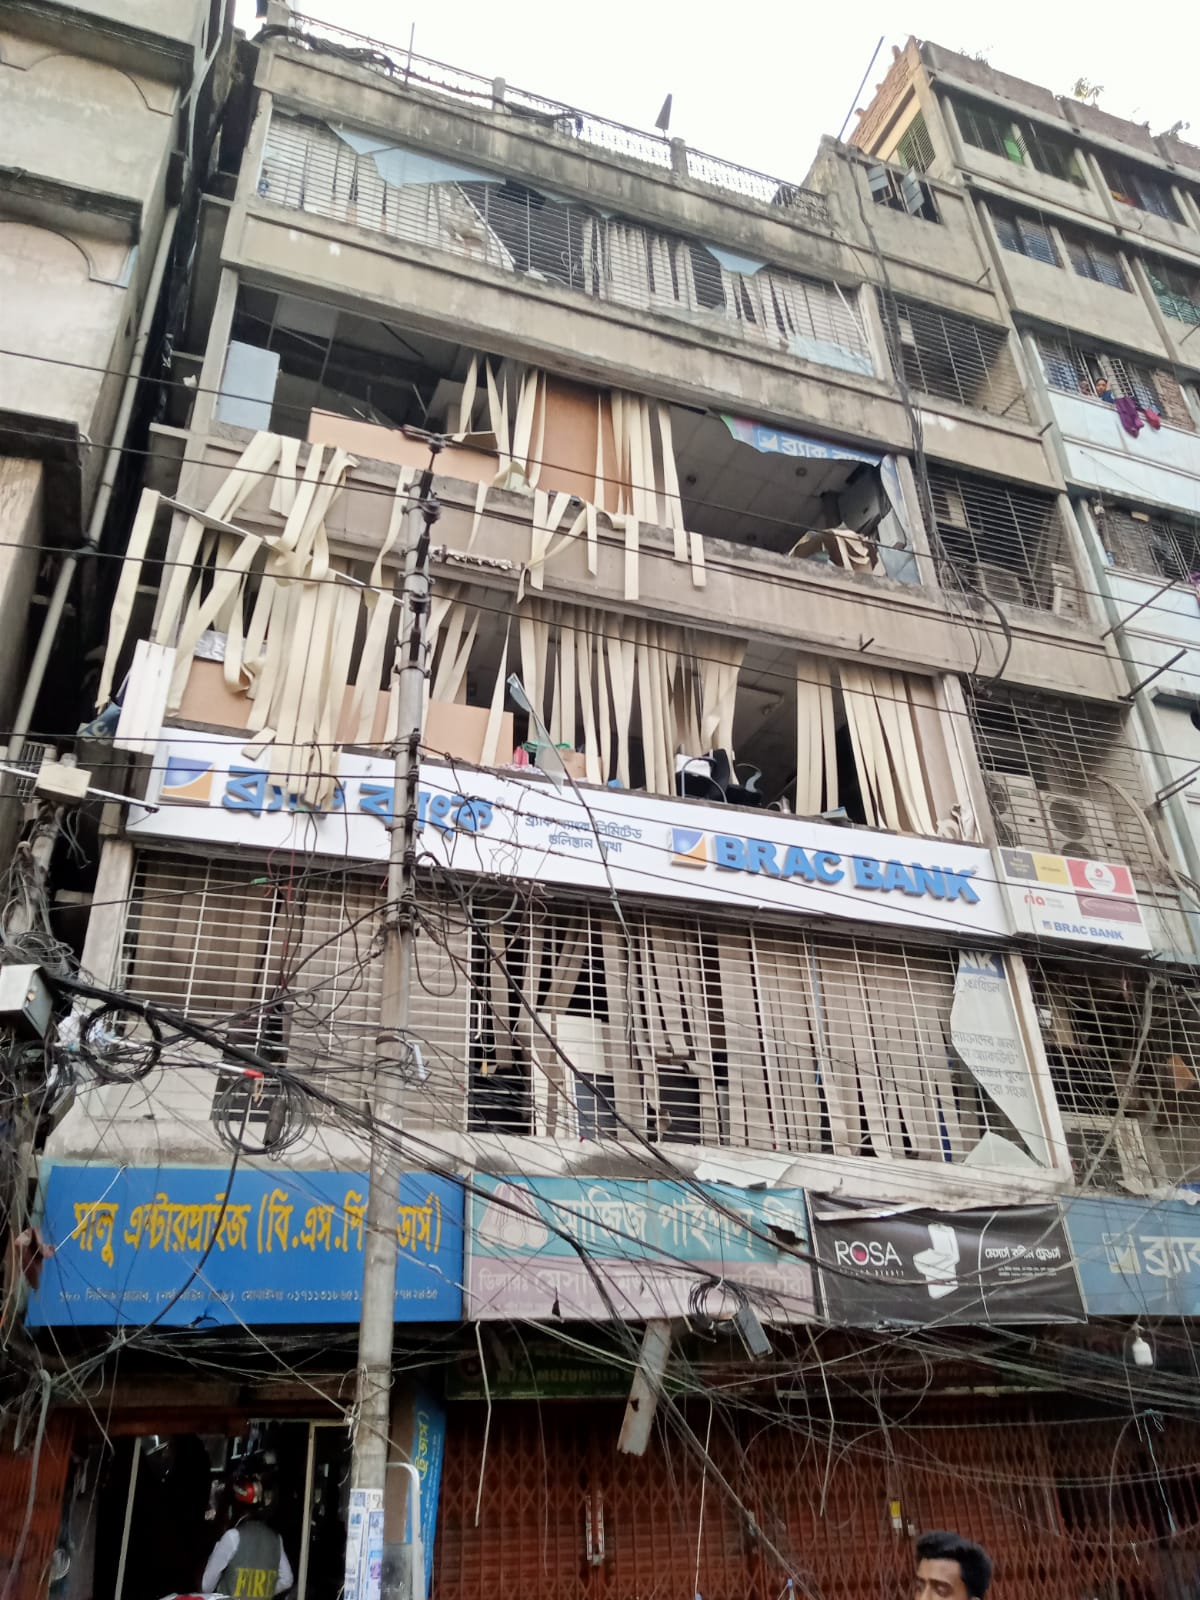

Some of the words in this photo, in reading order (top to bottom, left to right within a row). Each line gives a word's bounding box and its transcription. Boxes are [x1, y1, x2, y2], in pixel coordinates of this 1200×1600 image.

[713, 834, 845, 885] BRAC
[852, 854, 981, 904] BANK
[1054, 921, 1089, 935] BRAC
[1090, 927, 1124, 941] BANK
[834, 1240, 903, 1266] ROSA
[234, 1567, 277, 1598] FIRE
